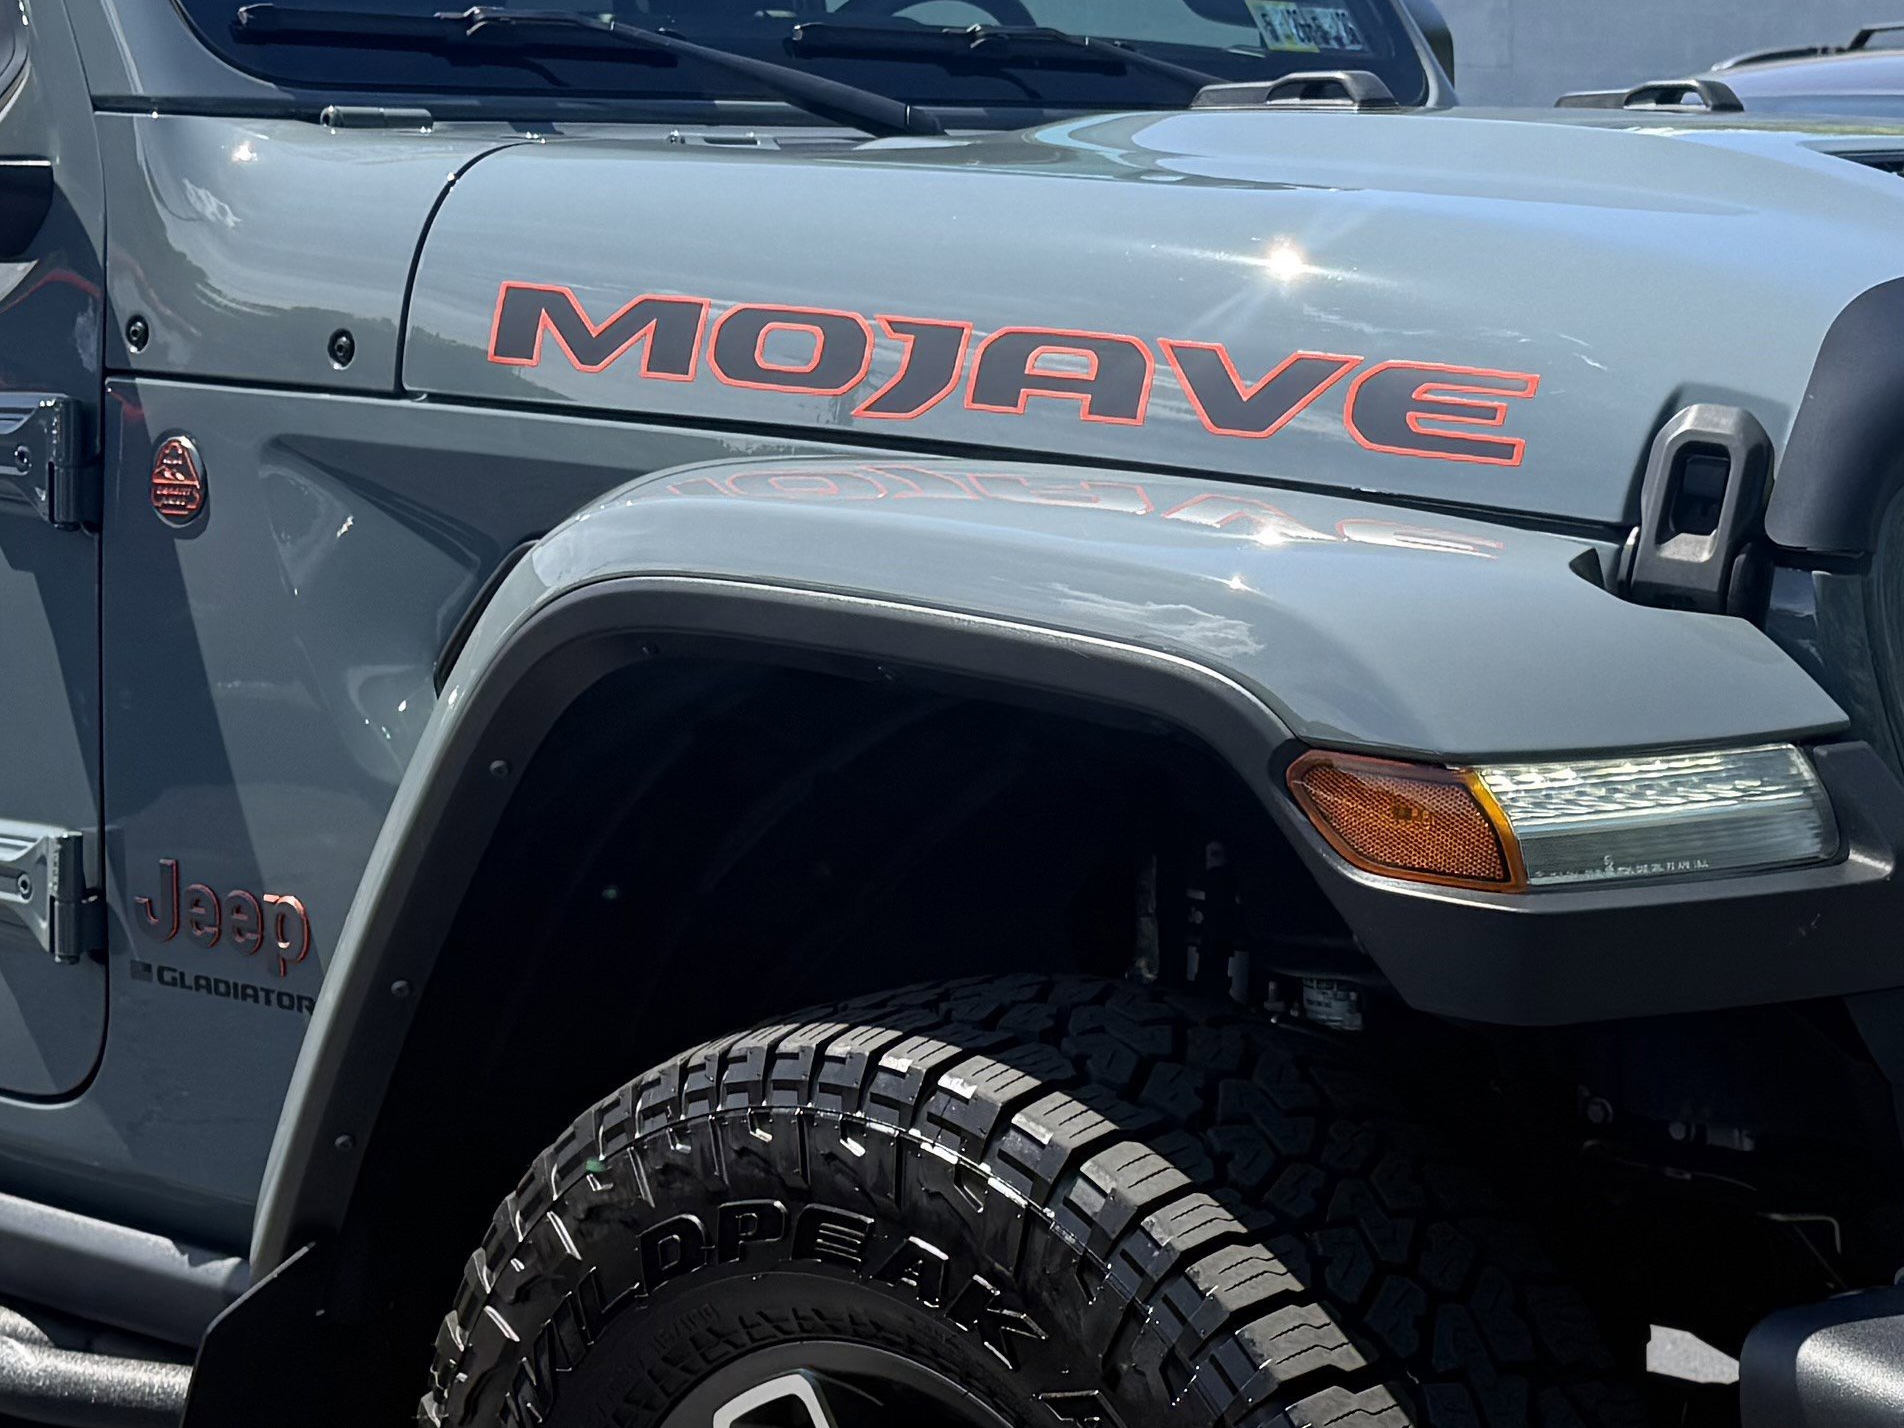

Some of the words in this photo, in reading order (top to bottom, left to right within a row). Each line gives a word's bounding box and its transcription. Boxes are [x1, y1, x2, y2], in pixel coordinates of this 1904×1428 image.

[487, 280, 1540, 468] MOJAVE
[134, 858, 312, 978] Jeep
[156, 965, 317, 1016] GLADIATOR
